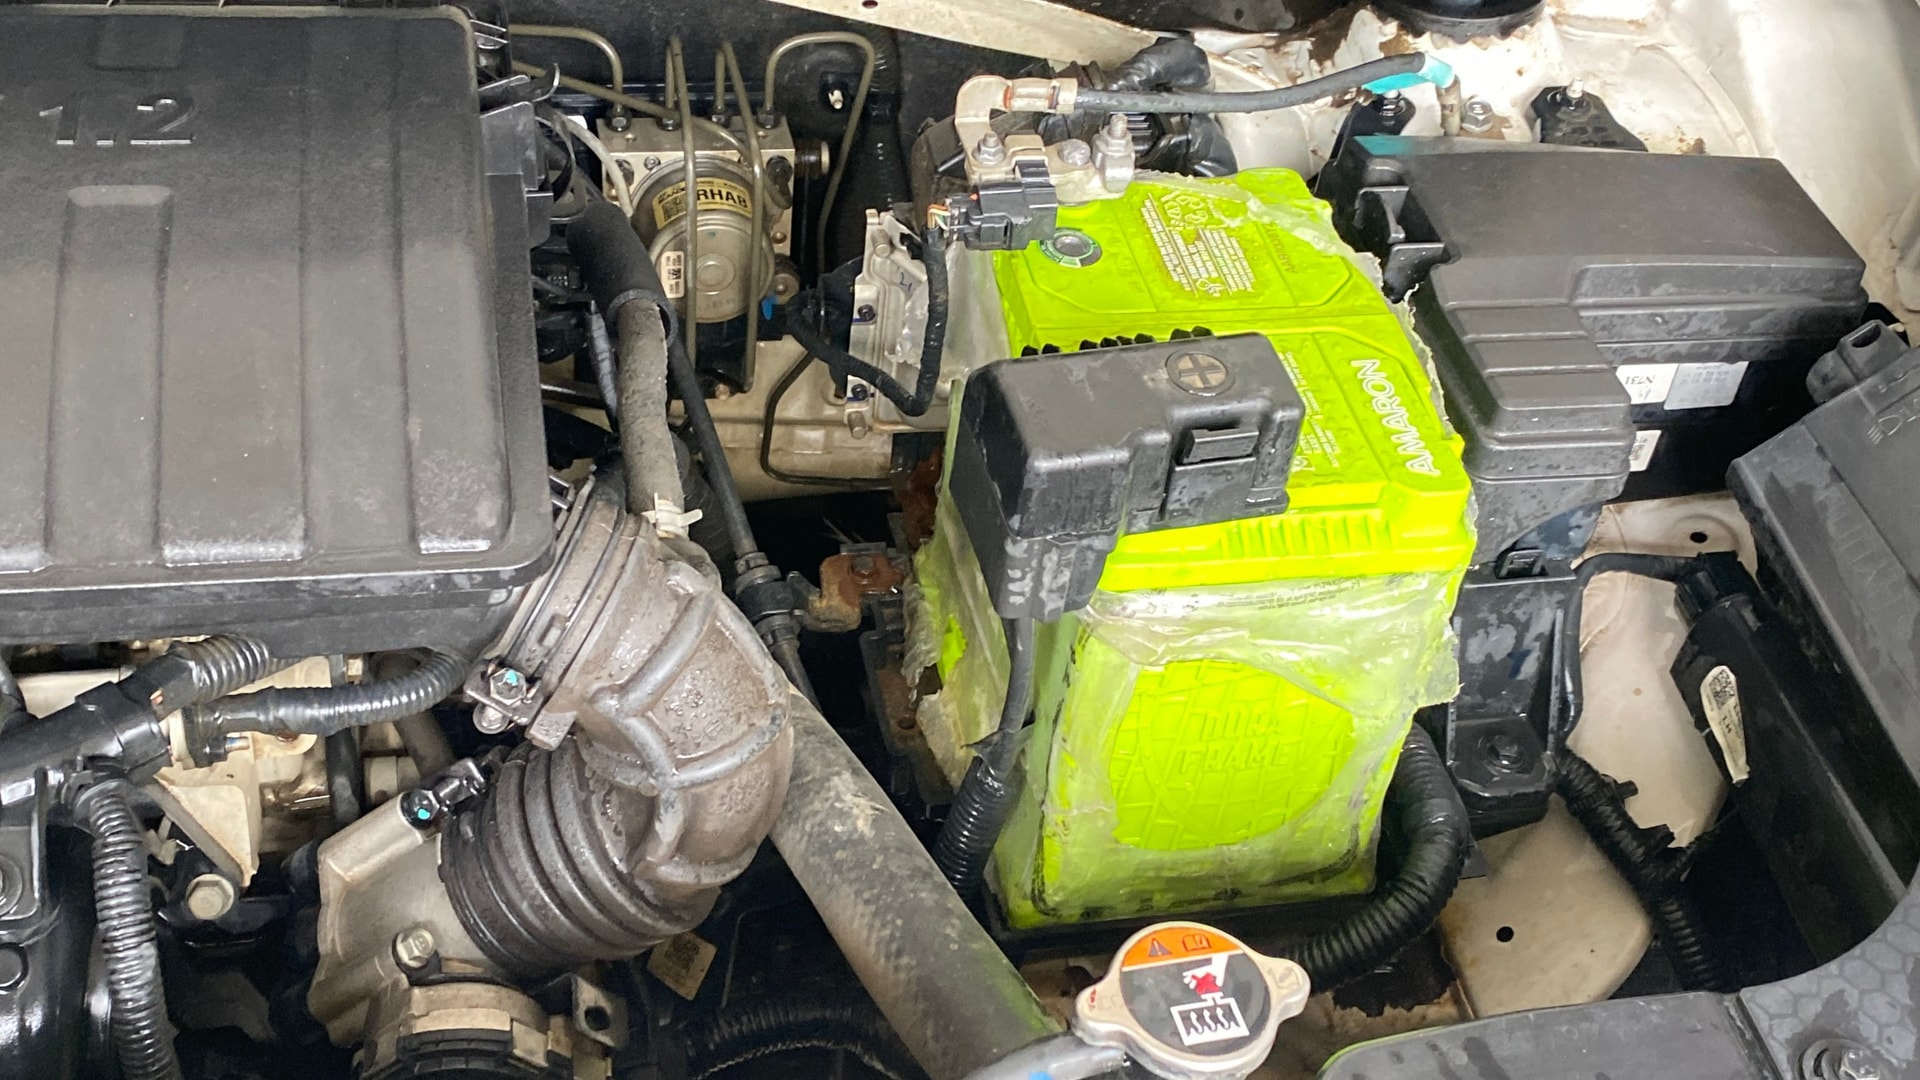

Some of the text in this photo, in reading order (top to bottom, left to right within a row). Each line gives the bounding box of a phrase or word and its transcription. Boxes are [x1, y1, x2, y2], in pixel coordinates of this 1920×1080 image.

[38, 95, 197, 146] 1.2
[1350, 358, 1441, 477] AMARON
[1176, 739, 1293, 775] FRAME
